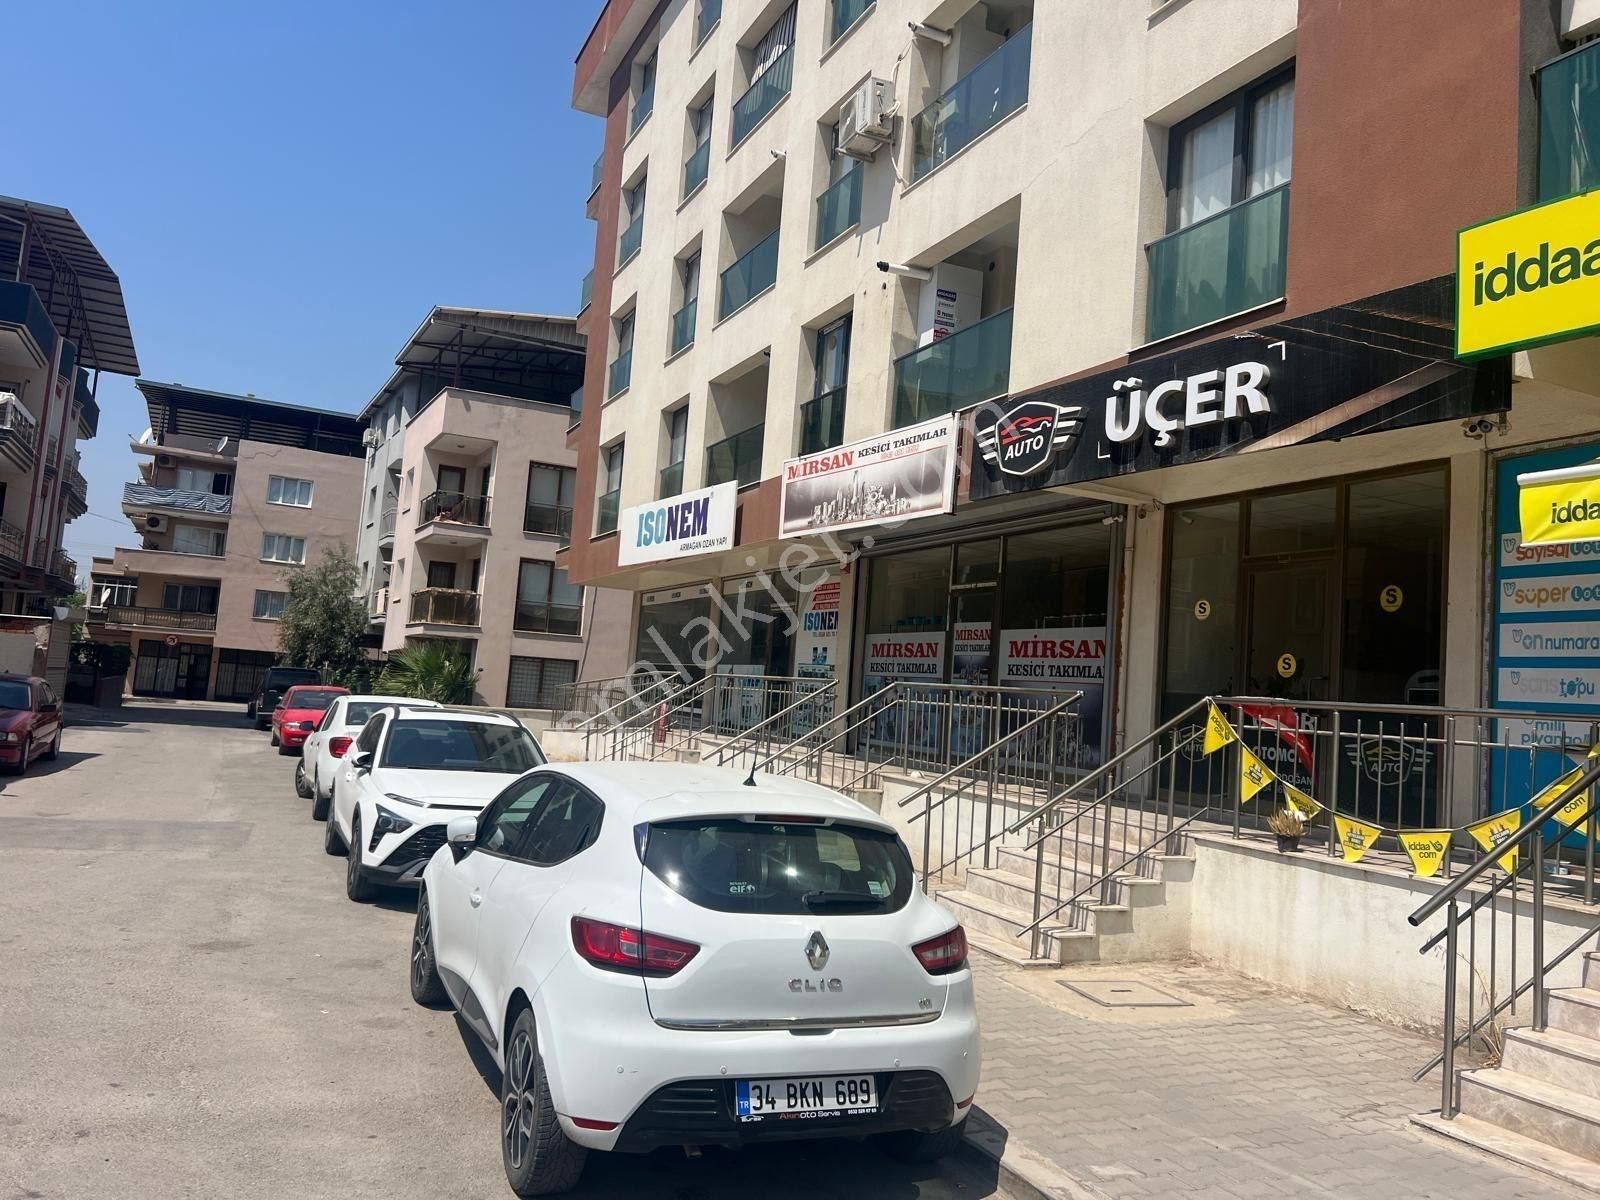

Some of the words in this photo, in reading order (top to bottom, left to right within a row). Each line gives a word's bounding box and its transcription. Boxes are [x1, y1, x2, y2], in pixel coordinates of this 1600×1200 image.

[1474, 238, 1600, 307] iddaa
[1104, 361, 1272, 447] ÜÇER
[787, 450, 855, 480] MİRSAN
[858, 439, 891, 458] KESİCİ
[893, 427, 948, 449] TAKIMLAR
[1004, 433, 1045, 462] AUTO
[636, 497, 710, 548] ISONEM
[871, 638, 939, 658] MİRSAN
[897, 662, 938, 674] TAKIMLAR
[1048, 664, 1104, 679] TAKIMLA
[1563, 795, 1587, 815] com
[1408, 841, 1431, 851] iddaa
[1419, 850, 1437, 859] com
[751, 1083, 777, 1111] 34
[786, 1081, 824, 1109] BKN
[835, 1079, 872, 1106] 689
[738, 1101, 750, 1110] TR
